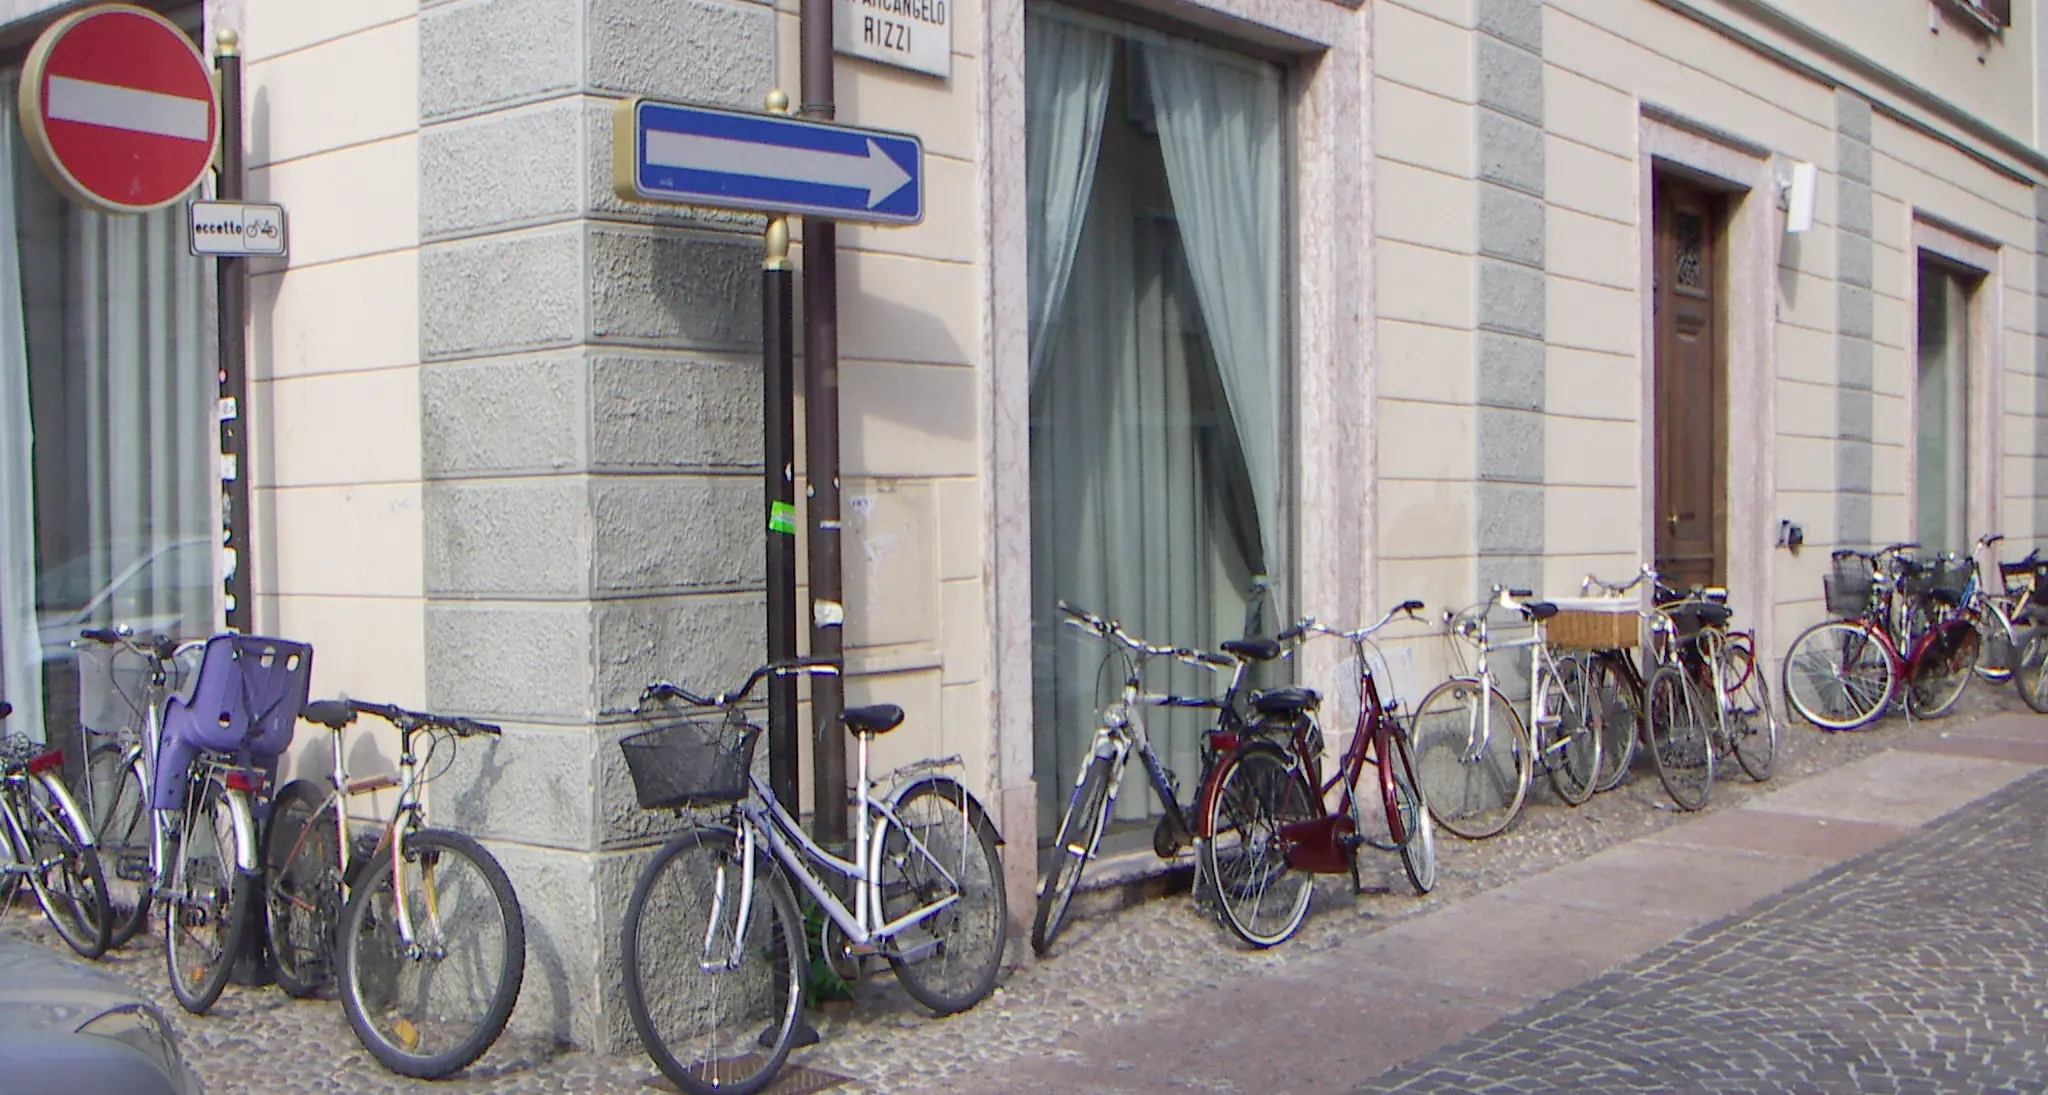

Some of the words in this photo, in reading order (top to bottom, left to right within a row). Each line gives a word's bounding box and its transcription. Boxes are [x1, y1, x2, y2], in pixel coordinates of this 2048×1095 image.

[862, 0, 945, 25] ANGELO
[864, 15, 911, 53] RIZZI
[195, 220, 242, 234] eccetto
